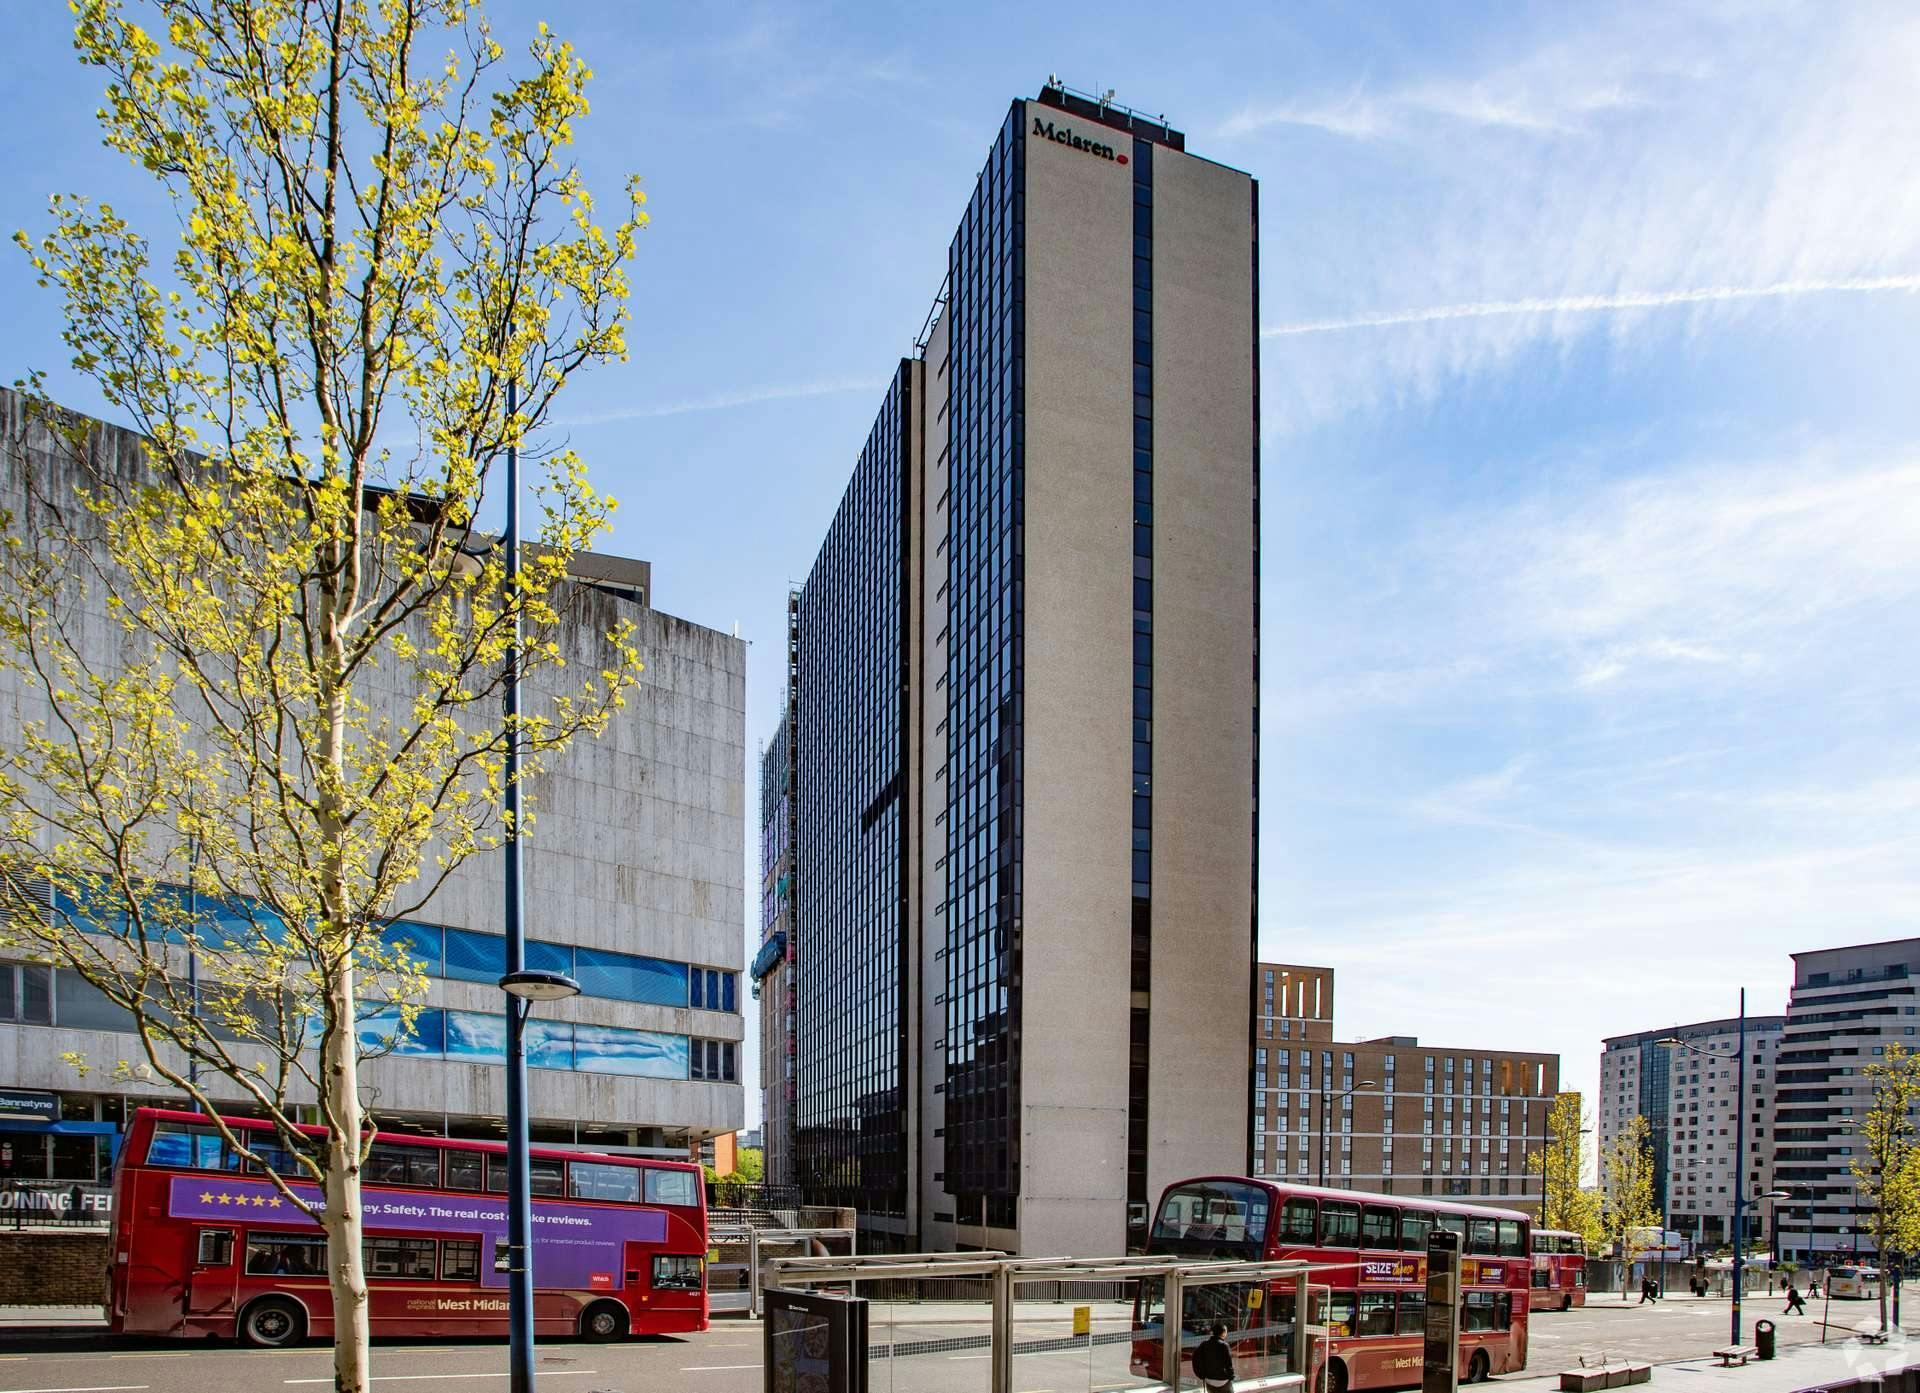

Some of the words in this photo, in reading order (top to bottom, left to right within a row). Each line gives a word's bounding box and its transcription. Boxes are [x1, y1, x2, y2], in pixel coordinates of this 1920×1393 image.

[383, 1204, 427, 1217] Safety.
[429, 1206, 452, 1217] The
[454, 1209, 478, 1219] real
[480, 1211, 505, 1221] cost
[547, 1215, 592, 1226] reviews.
[1365, 1262, 1391, 1274] SEIZE
[437, 1299, 472, 1310] West
[1395, 1358, 1411, 1369] West
